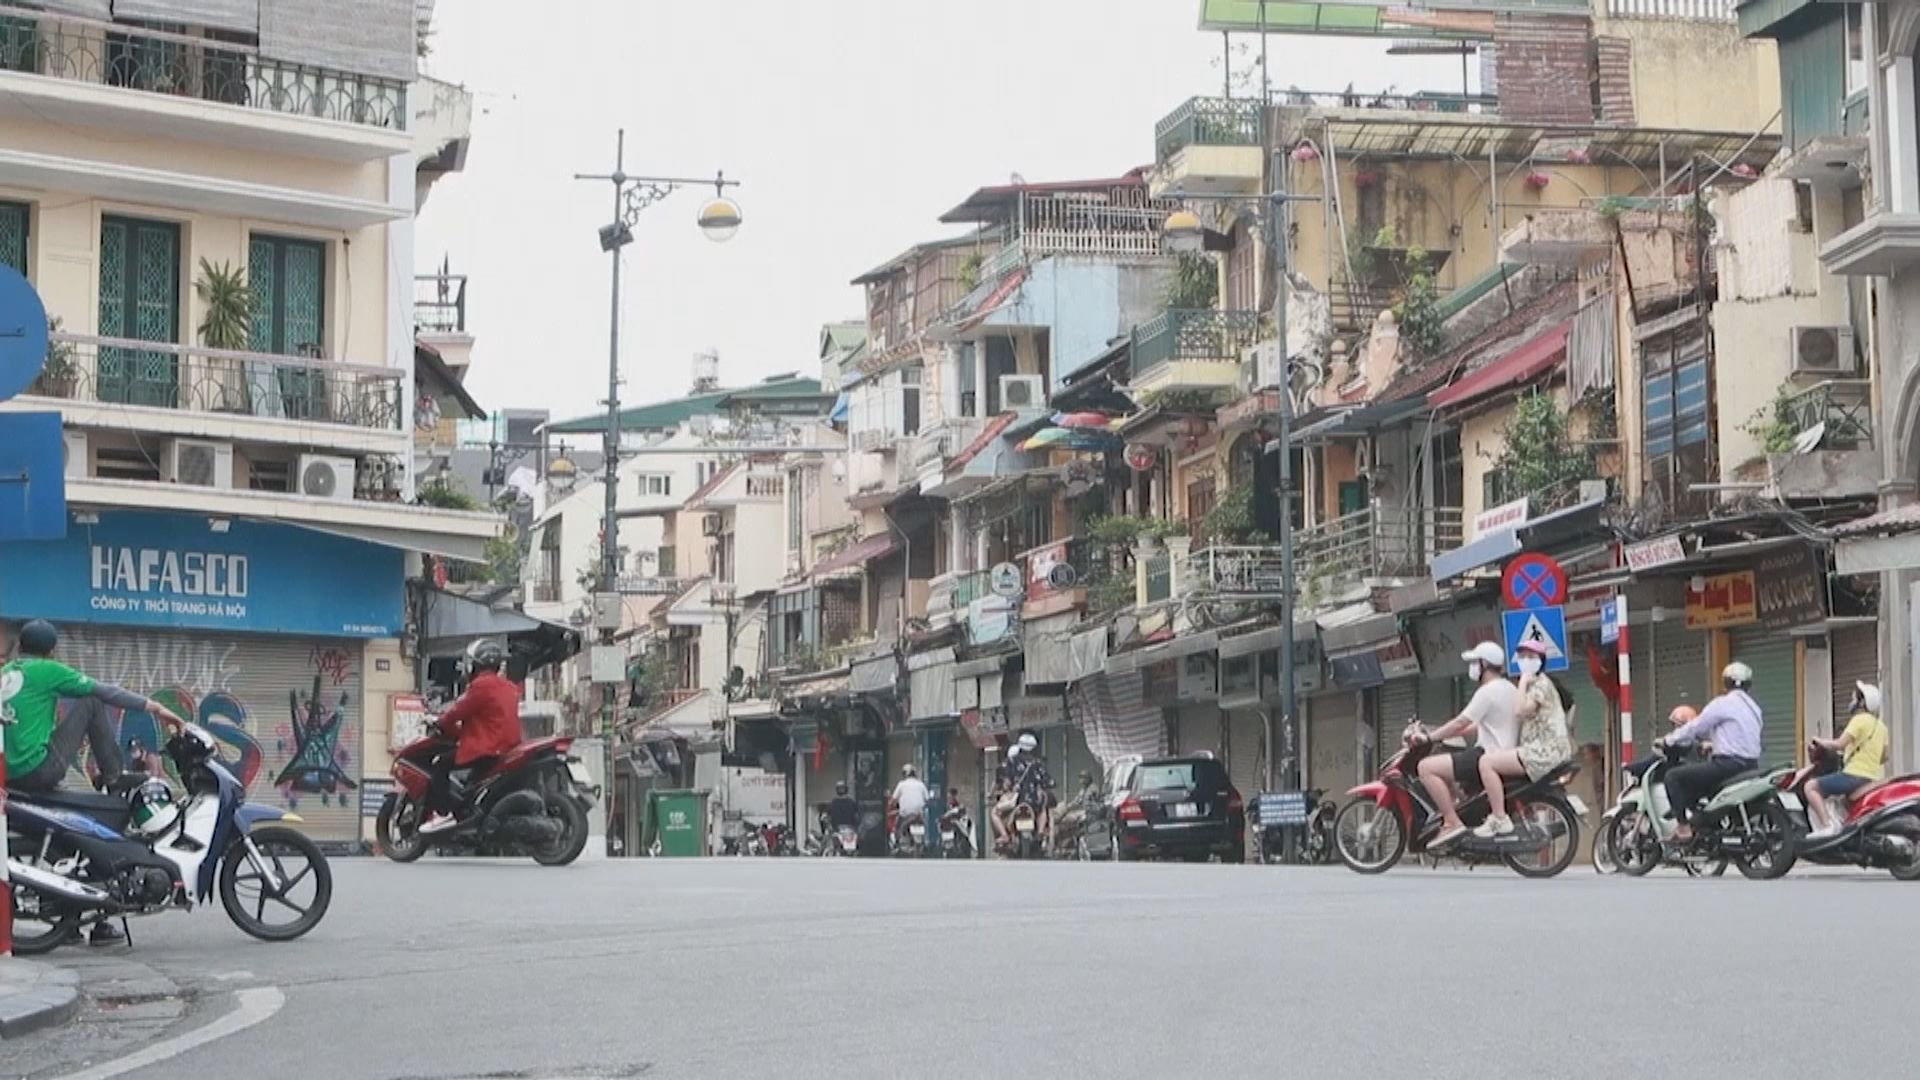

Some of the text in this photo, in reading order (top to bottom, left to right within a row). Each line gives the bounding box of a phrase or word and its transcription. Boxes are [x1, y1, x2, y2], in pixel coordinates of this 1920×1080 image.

[91, 545, 248, 598] HAFASCO
[91, 595, 126, 610] CÔNG
[128, 599, 140, 611] TY
[171, 602, 206, 615] TRANG
[226, 603, 246, 619] NỘI
